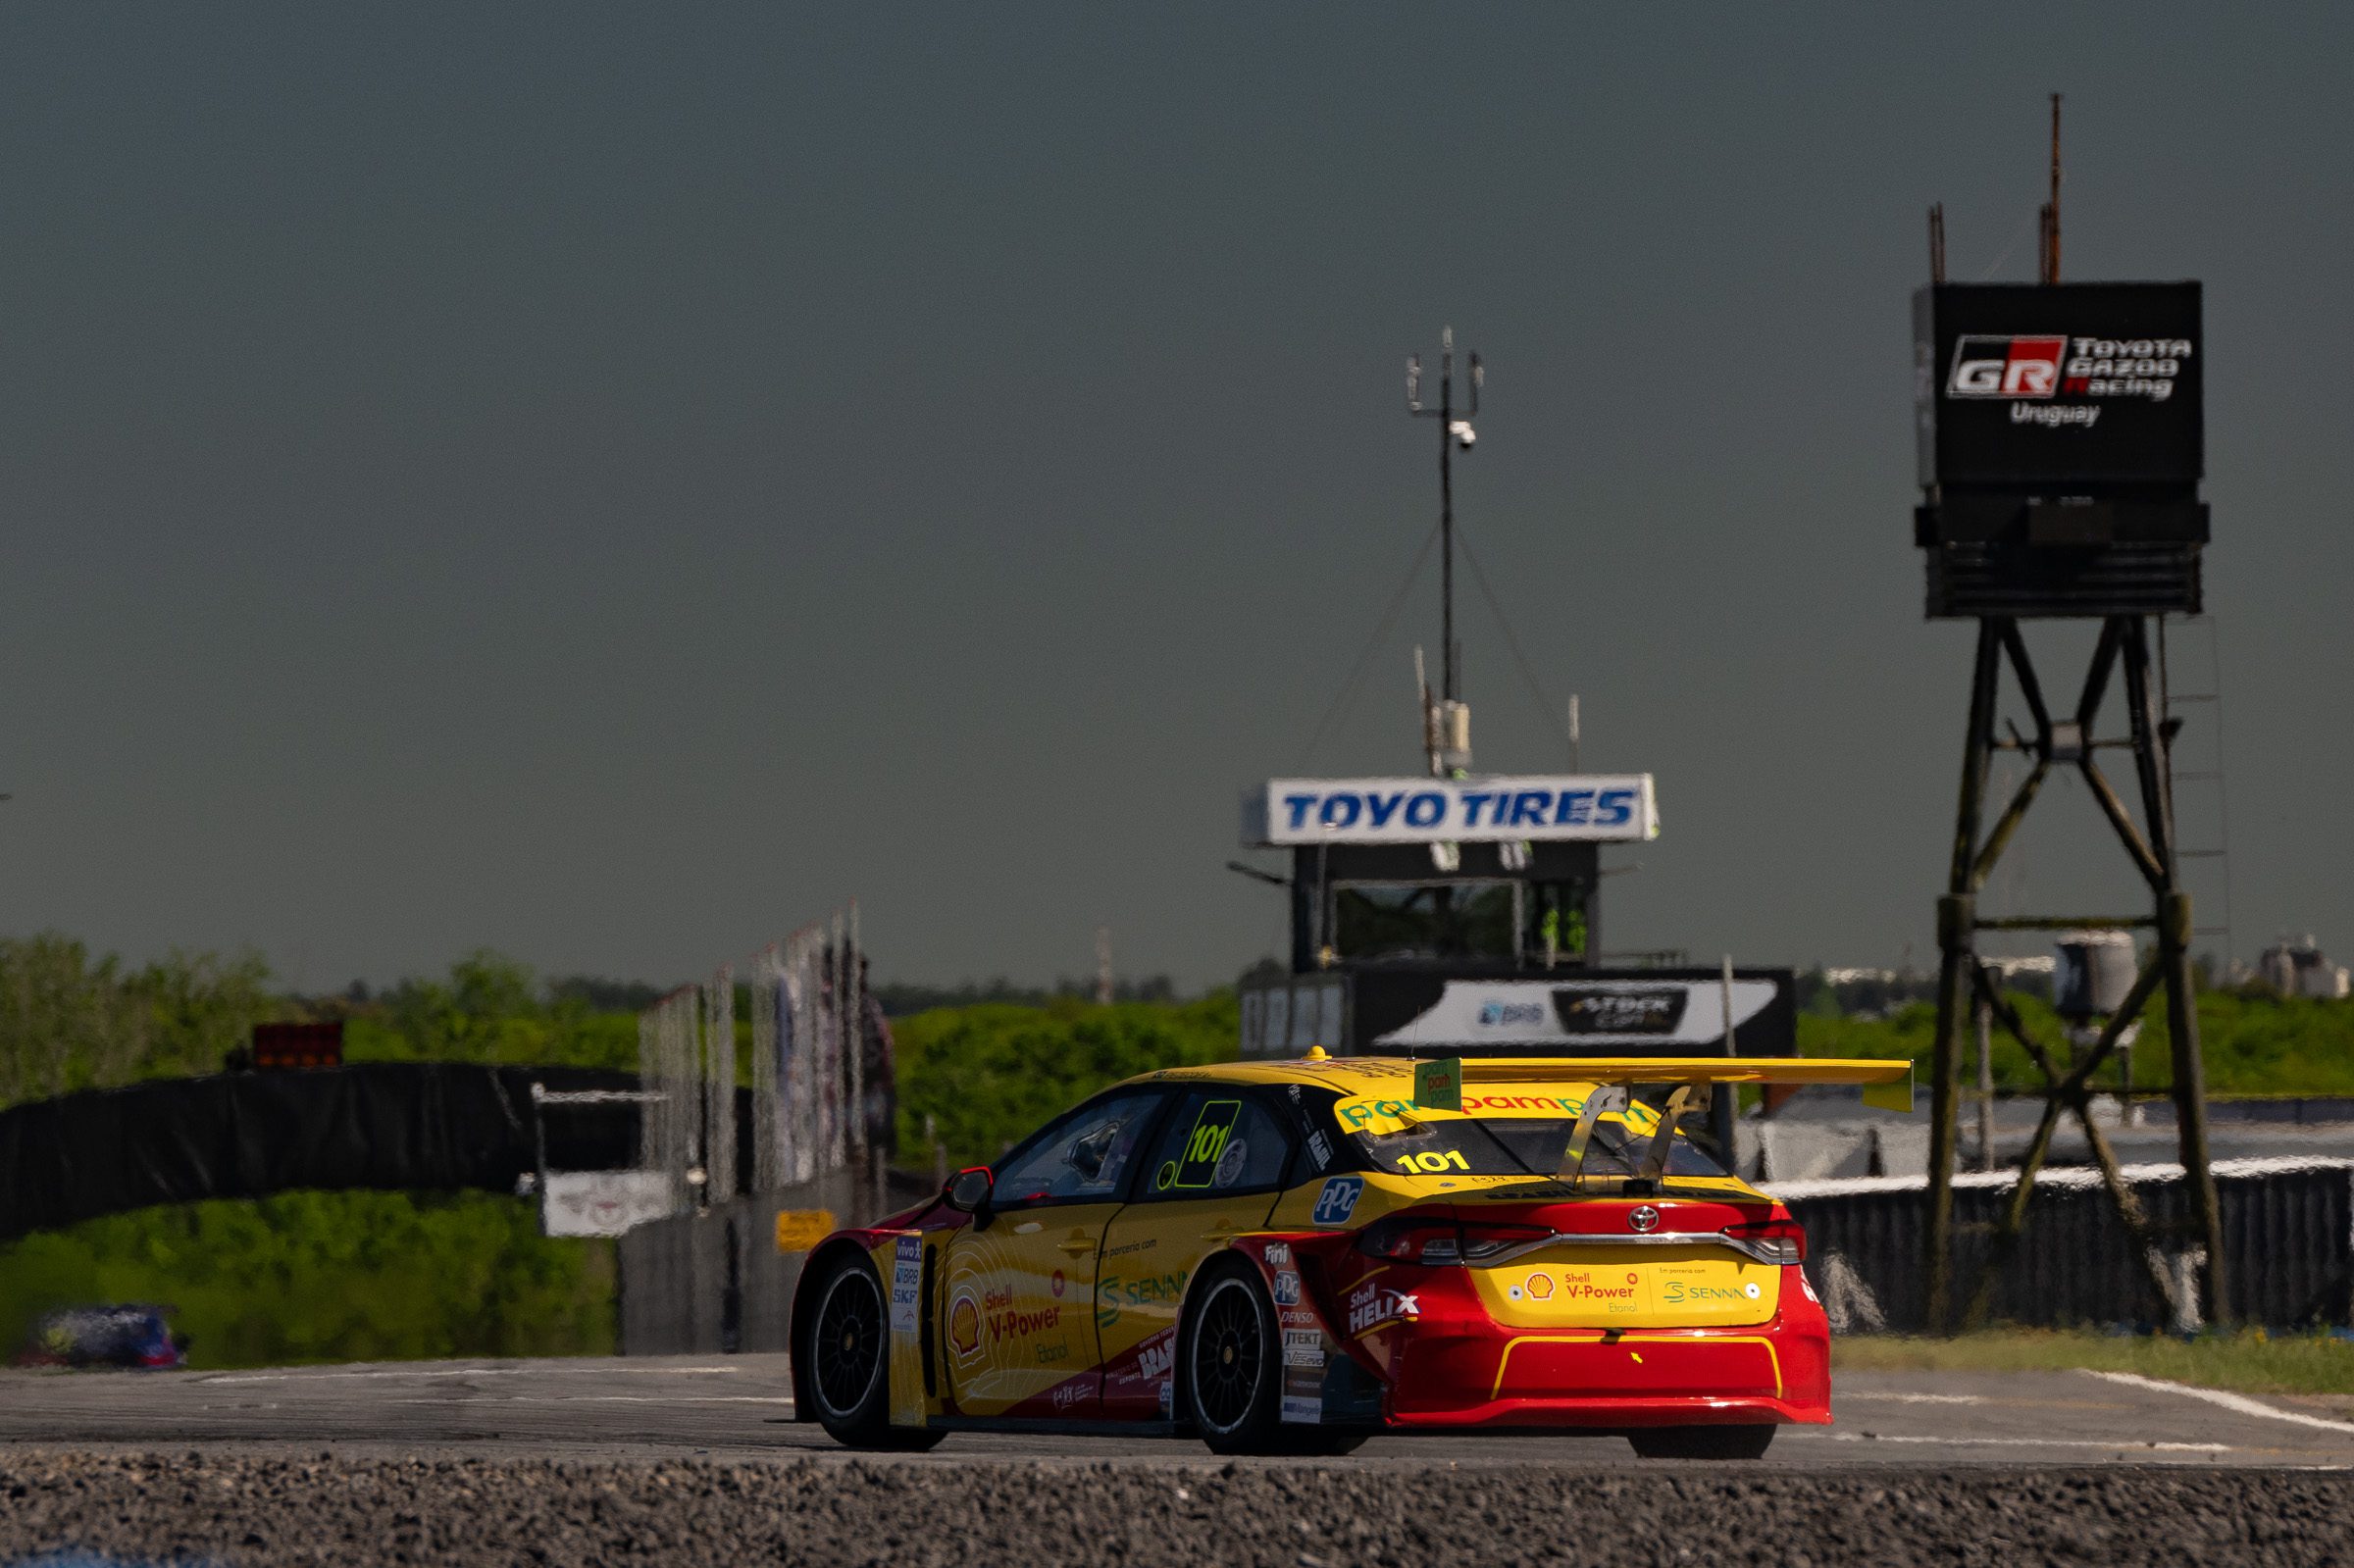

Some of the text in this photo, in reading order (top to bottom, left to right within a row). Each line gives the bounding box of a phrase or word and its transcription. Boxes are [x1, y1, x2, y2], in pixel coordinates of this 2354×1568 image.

[2072, 337, 2192, 359] TOYOTA
[1958, 360, 2055, 390] GR
[2066, 357, 2179, 379] GAZOO
[2063, 378, 2175, 402] Racing
[2011, 402, 2101, 428] Uruguay
[1284, 789, 1635, 832] TOYO TIRES
[1428, 1075, 1451, 1094] pam
[1340, 1099, 1419, 1128] pa
[1189, 1124, 1230, 1163] 101
[1396, 1150, 1470, 1175] 101
[1316, 1182, 1360, 1219] PPG
[896, 1241, 915, 1258] vivo
[1141, 1239, 1157, 1251] com
[1264, 1243, 1289, 1264] Fini
[903, 1269, 919, 1285] BRB
[1275, 1275, 1299, 1302] PPG
[1565, 1273, 1590, 1284] Shell
[894, 1290, 917, 1304] SKF
[986, 1284, 1012, 1310] Shell
[1350, 1283, 1375, 1310] Shell
[1566, 1286, 1635, 1299] V-Power
[1689, 1287, 1746, 1299] SENNA
[1281, 1311, 1314, 1324] DENSO
[1349, 1290, 1420, 1334] HELIX
[1609, 1302, 1638, 1313] Etanol
[989, 1306, 1060, 1342] V-Power
[1036, 1333, 1068, 1364] Etanol
[1285, 1332, 1319, 1346] JTEKT
